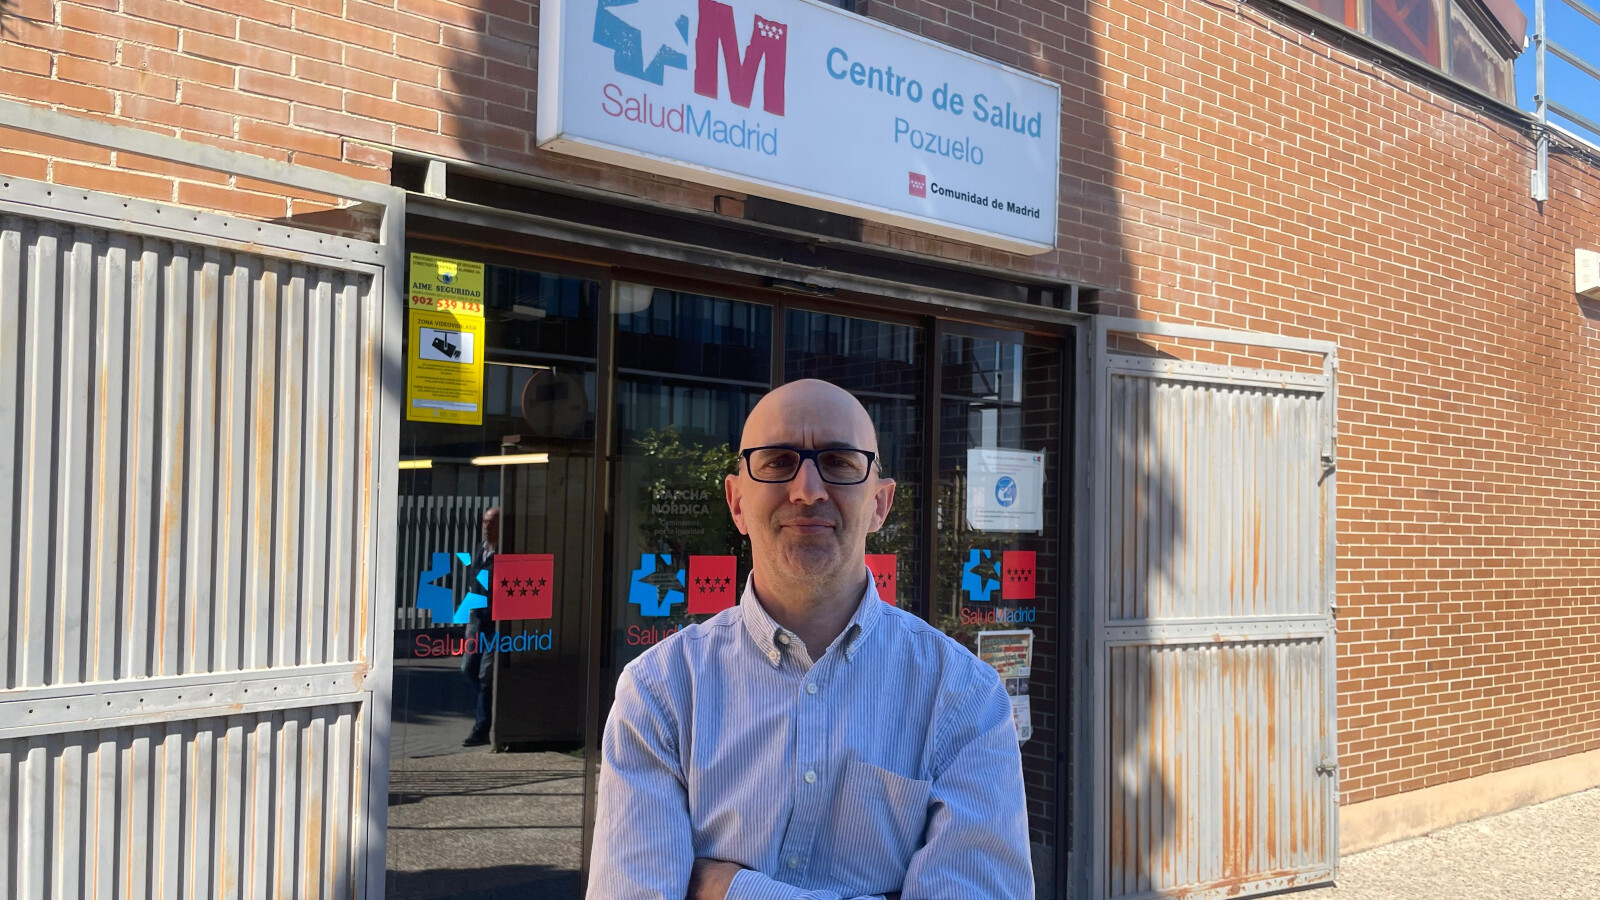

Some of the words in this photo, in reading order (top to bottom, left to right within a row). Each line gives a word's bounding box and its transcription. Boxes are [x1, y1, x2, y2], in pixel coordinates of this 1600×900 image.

[826, 47, 923, 103] Centro
[932, 83, 964, 116] de
[972, 93, 1042, 139] Salud
[602, 83, 777, 156] SaludMadrid
[894, 116, 984, 165] Pozuelo
[930, 182, 989, 207] Comunidad
[991, 198, 1004, 210] de
[1006, 201, 1041, 219] Madrid
[413, 282, 432, 291] AIME
[436, 285, 481, 297] SEGURIDAD
[412, 295, 433, 305] 902
[436, 298, 457, 310] 539
[461, 302, 481, 313] 123
[417, 318, 434, 326] ZONA
[652, 489, 709, 500] MARCHA
[651, 501, 710, 515] NÓRDICA
[961, 606, 1036, 625] SaludMadrid
[414, 628, 552, 657] SaludMadrid
[627, 623, 683, 646] Salud
